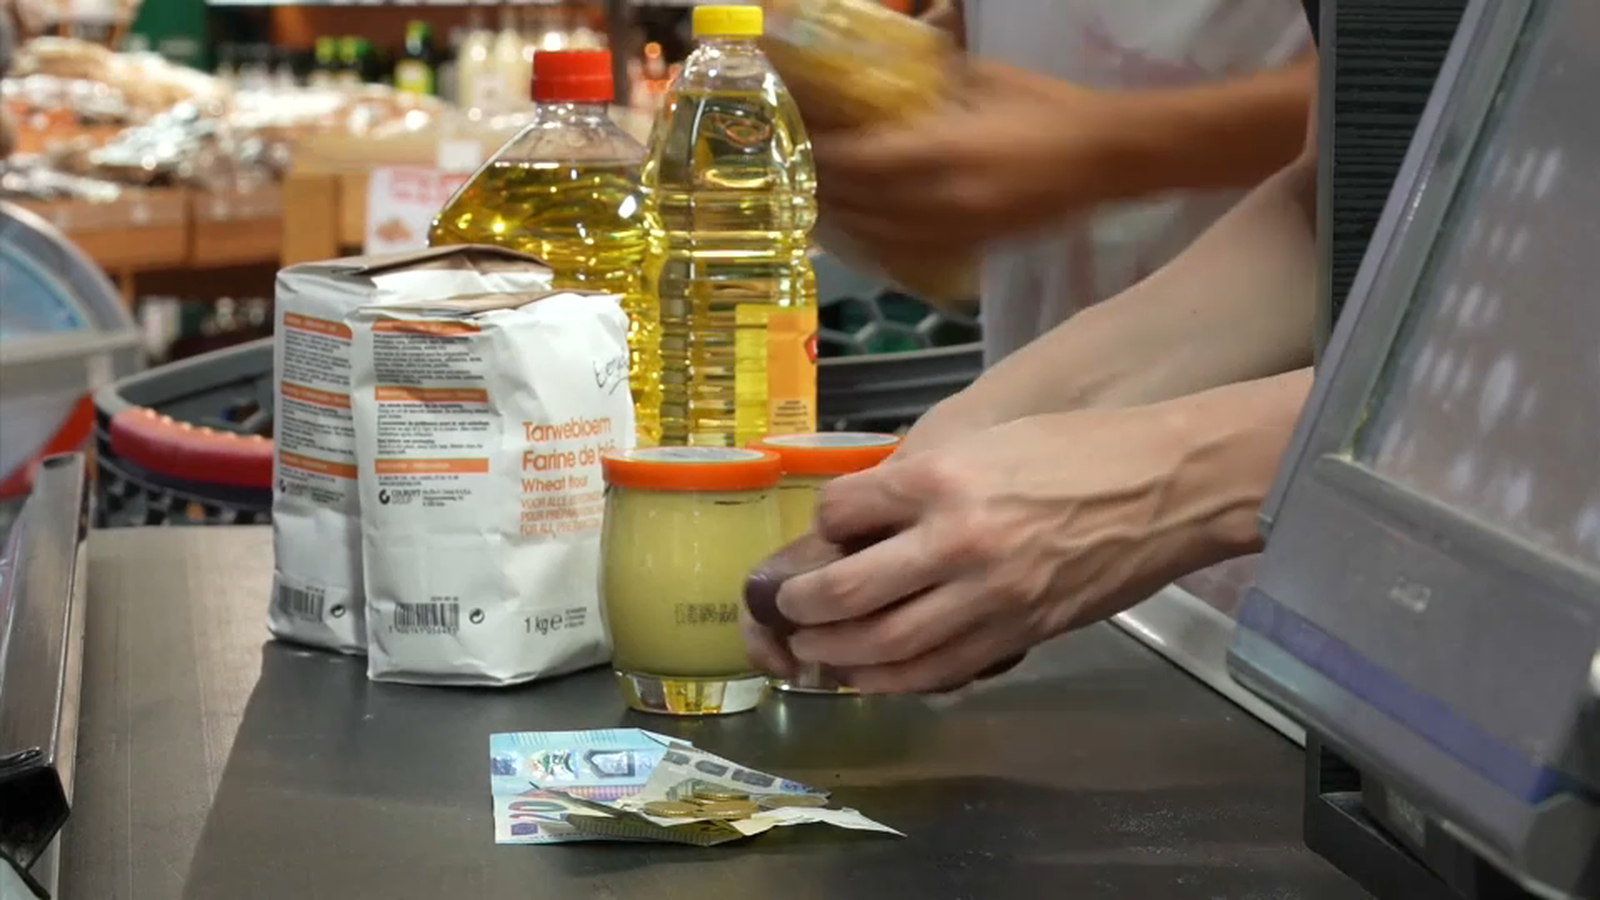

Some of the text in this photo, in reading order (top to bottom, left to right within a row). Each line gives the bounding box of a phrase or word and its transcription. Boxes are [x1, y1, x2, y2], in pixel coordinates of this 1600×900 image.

[522, 417, 611, 442] Tarwebloem
[522, 448, 575, 471] Farine
[579, 445, 595, 466] de
[521, 475, 588, 493] Wheat flour
[524, 616, 531, 634] 1
[534, 615, 549, 636] kg
